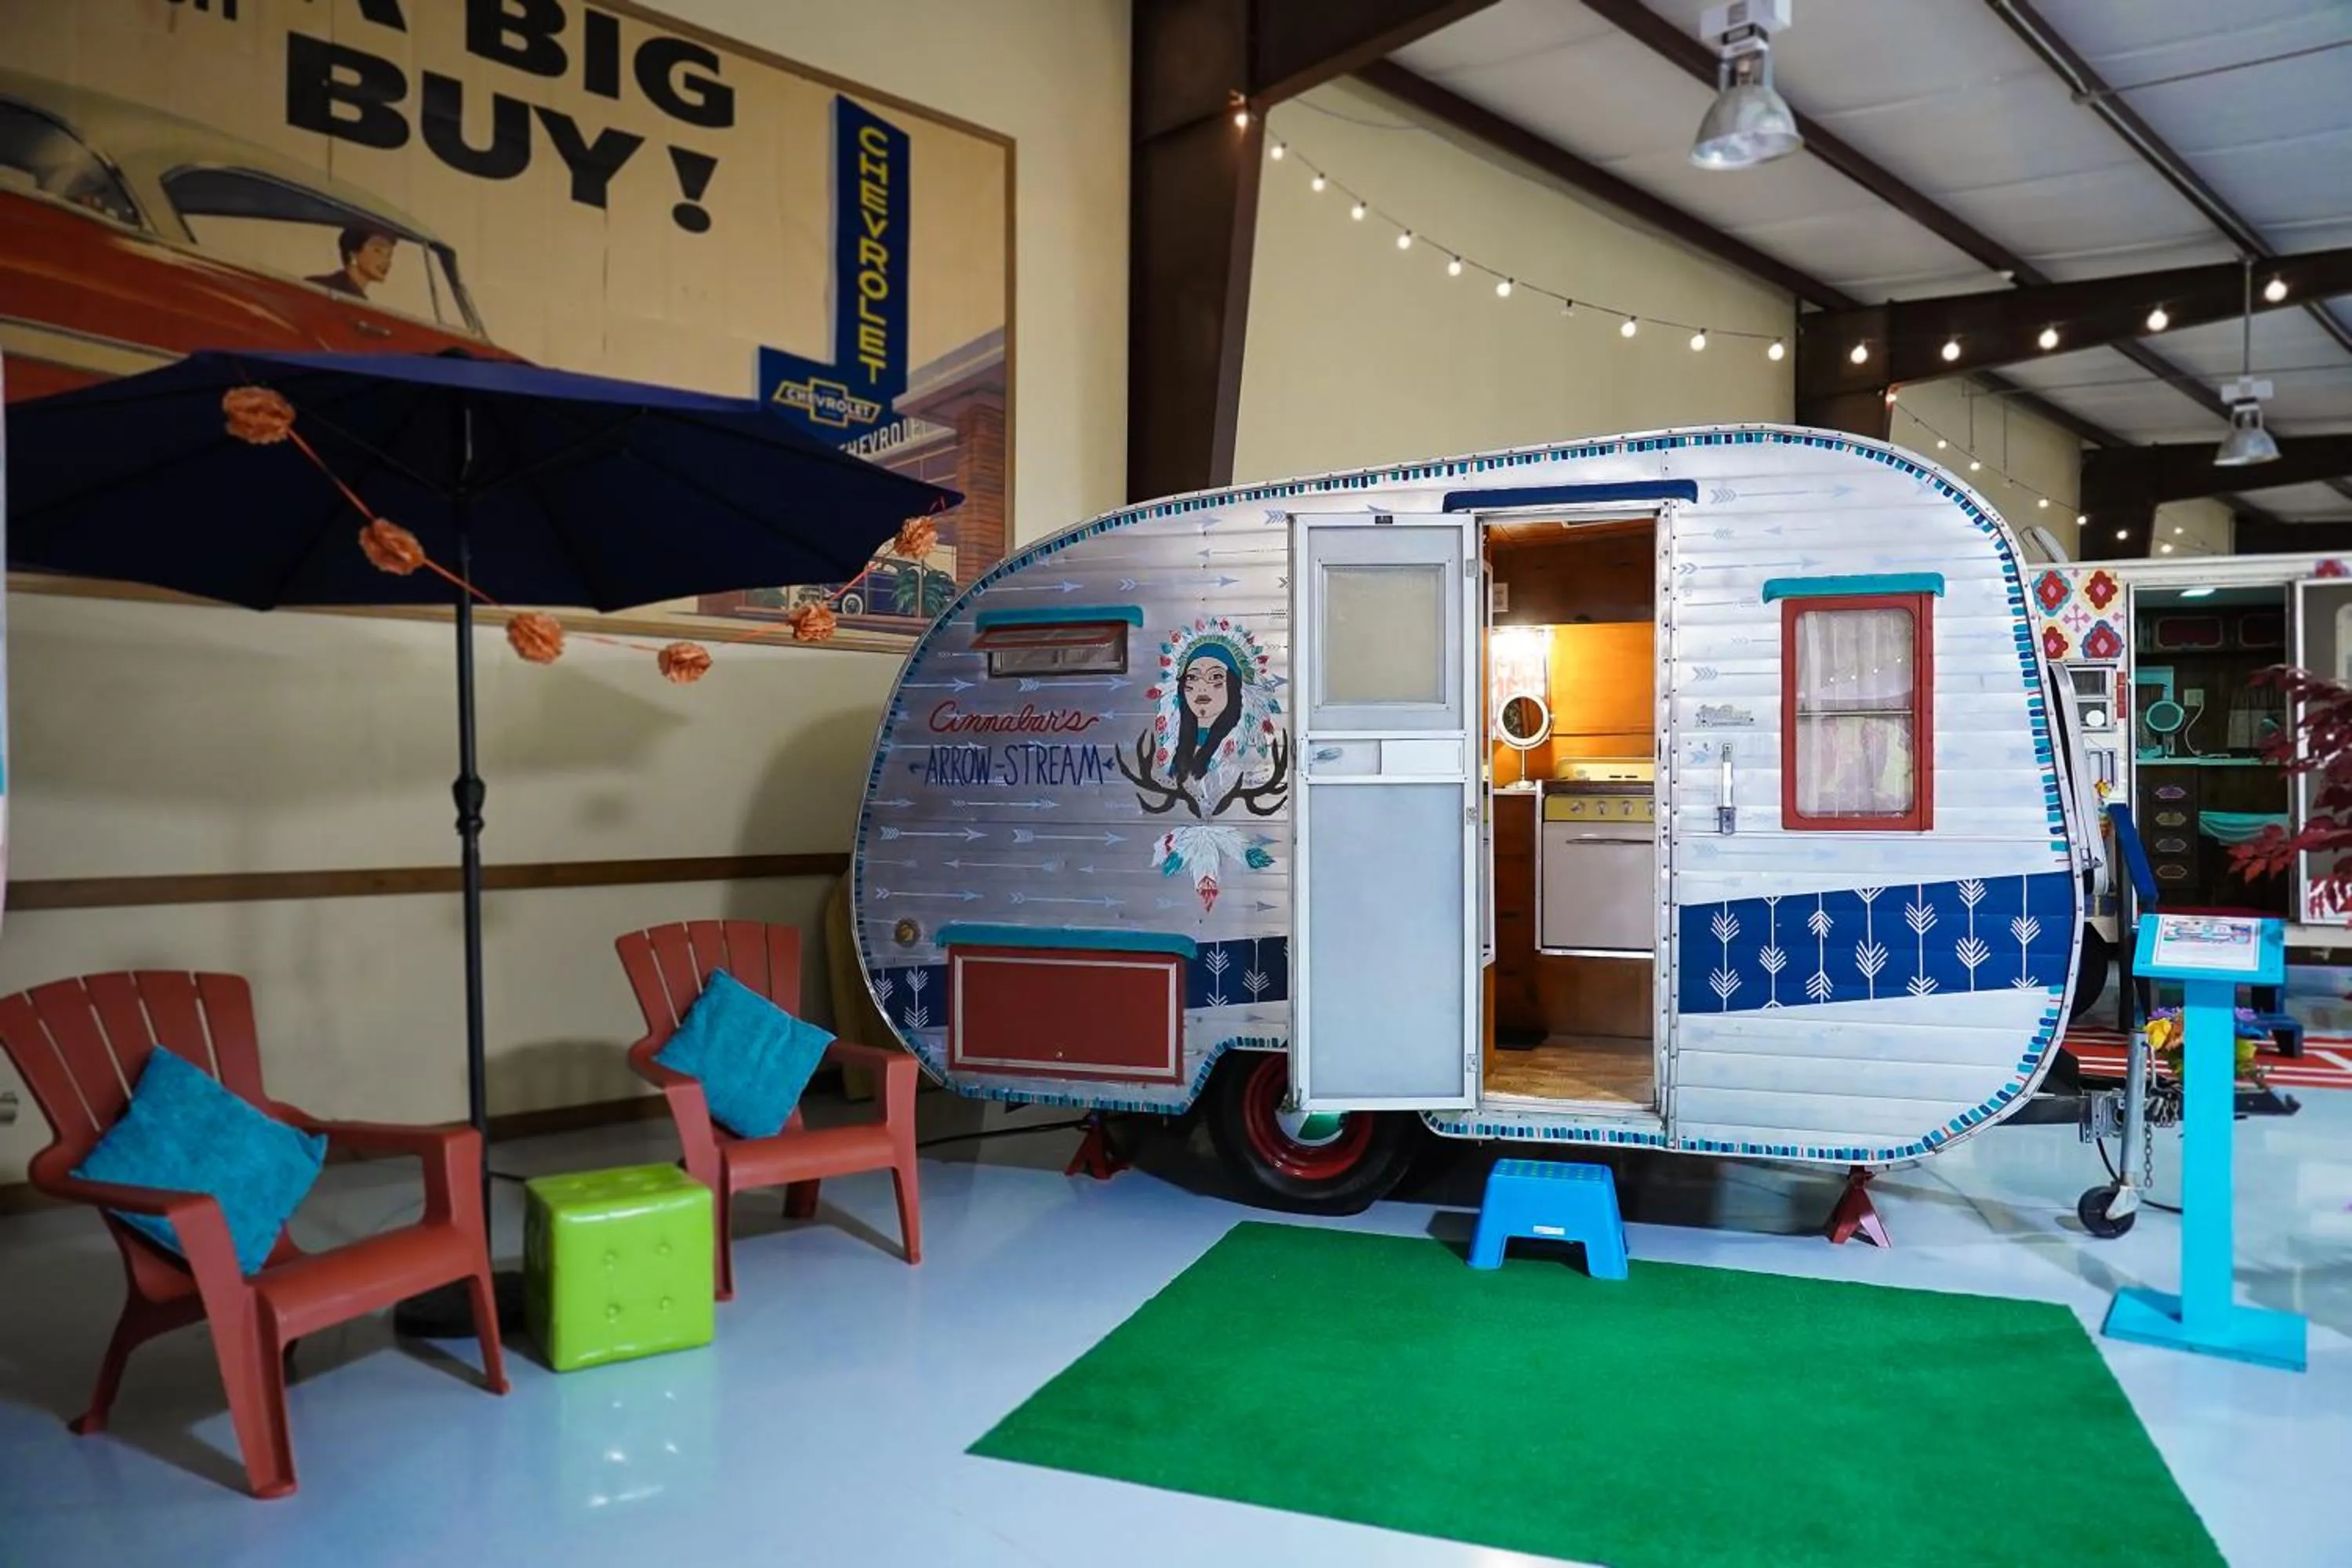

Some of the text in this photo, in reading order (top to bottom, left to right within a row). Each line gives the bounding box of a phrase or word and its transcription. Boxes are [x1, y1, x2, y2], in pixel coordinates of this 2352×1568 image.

[466, 0, 734, 129] BIG
[286, 31, 718, 233] BUY!
[858, 126, 889, 384] CHEVROLET
[786, 387, 872, 416] CHEVROLET
[838, 417, 928, 456] HEVROLET
[929, 700, 1099, 732] Cinnabar's
[924, 745, 1103, 786] ARROW-STREAM
